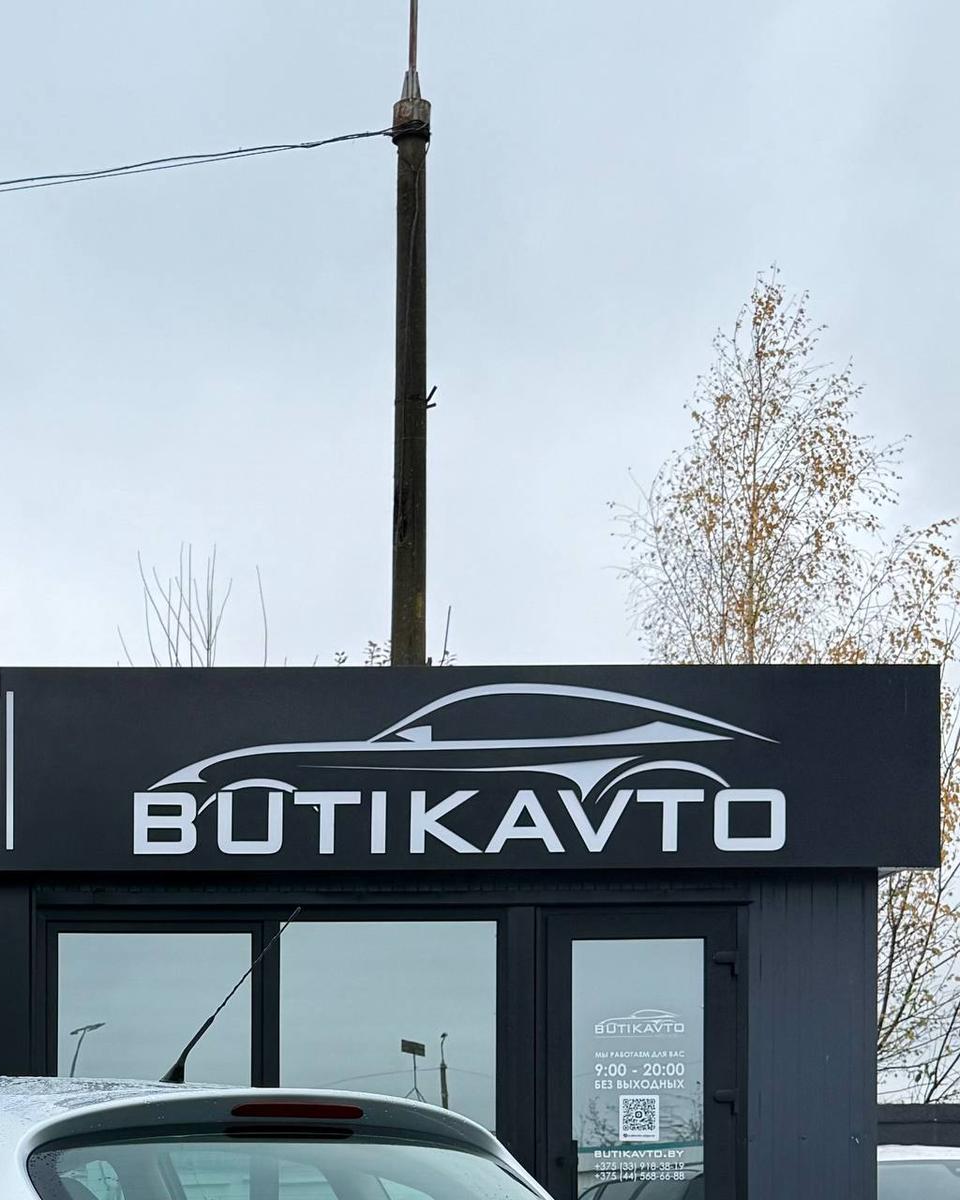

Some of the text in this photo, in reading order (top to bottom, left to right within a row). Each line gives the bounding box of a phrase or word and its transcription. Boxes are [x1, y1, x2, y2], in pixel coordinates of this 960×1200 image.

[133, 788, 787, 855] BUTIKAVTO
[594, 1023, 685, 1034] BUTIKAVTO
[595, 1063, 627, 1077] 9:00
[643, 1063, 685, 1077] 20:00
[595, 1080, 685, 1090] БЕЗ ВЫХОДНЫХ
[594, 1150, 685, 1158] BUTIKAVTO.BY
[595, 1162, 617, 1171] +375
[619, 1161, 637, 1173] (33)
[595, 1171, 685, 1182] +375 (44) 568-66-88
